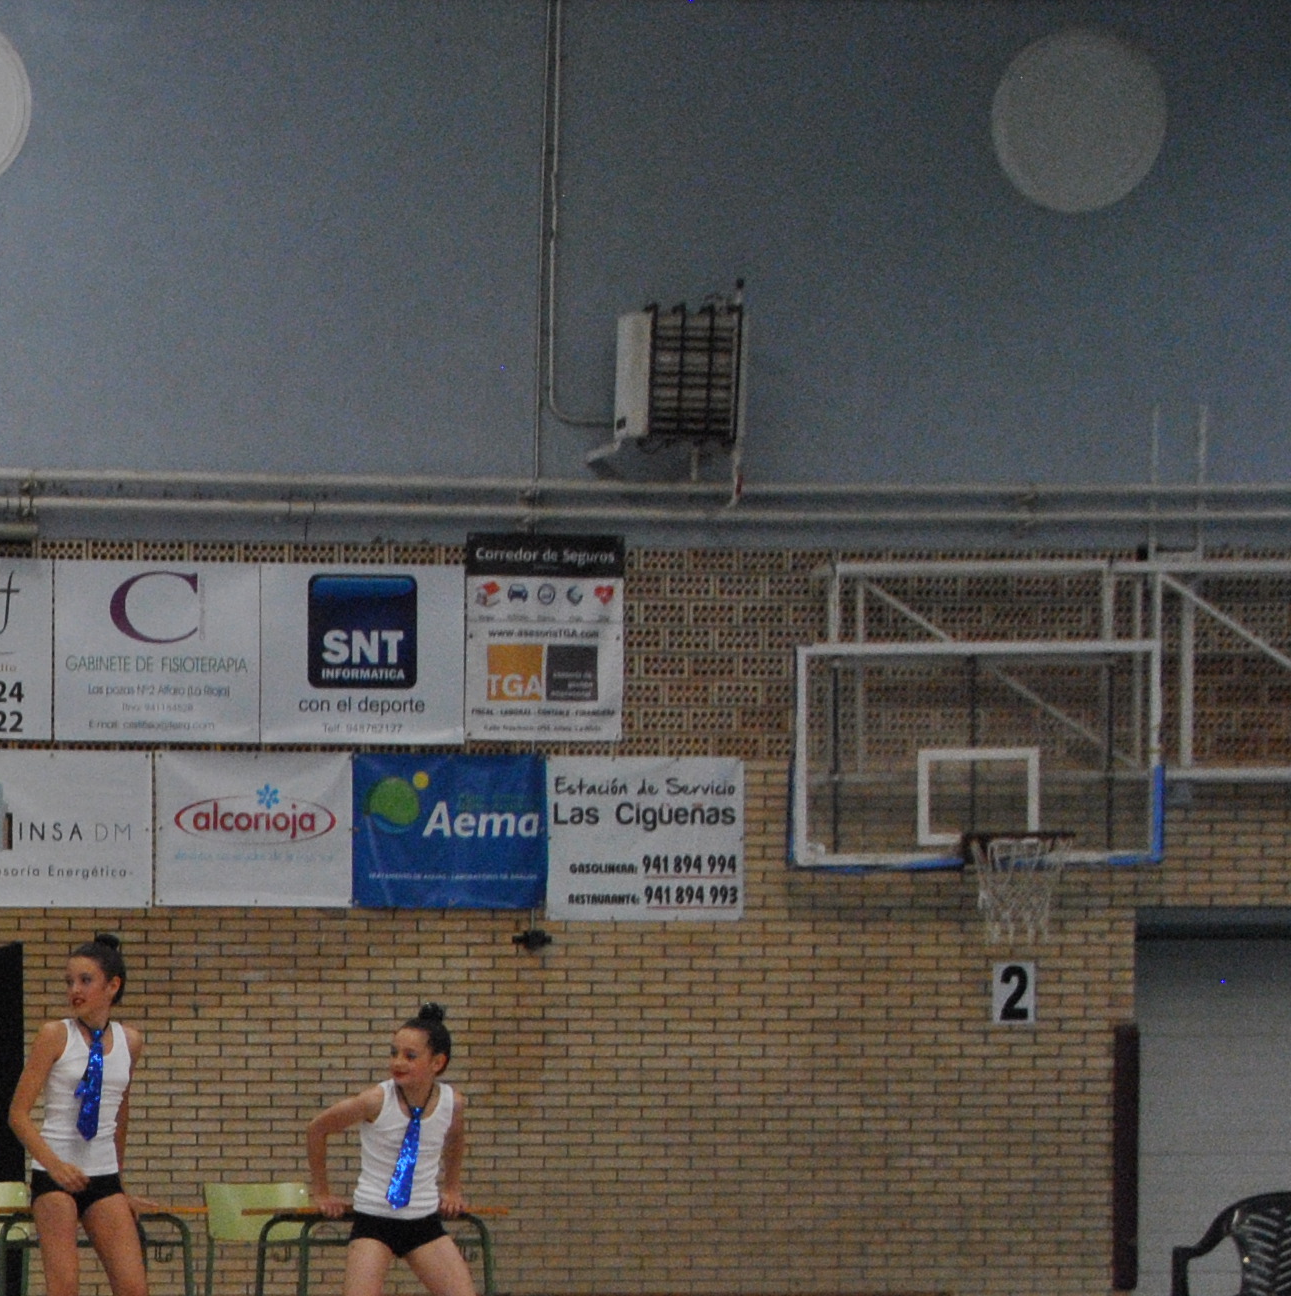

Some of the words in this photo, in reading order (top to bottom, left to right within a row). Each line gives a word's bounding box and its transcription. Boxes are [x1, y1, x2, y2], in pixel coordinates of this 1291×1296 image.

[475, 547, 537, 562] Corredor
[542, 548, 558, 562] de
[562, 549, 616, 566] Seguros
[321, 629, 405, 665] SNT
[65, 655, 132, 673] GABINETE
[135, 656, 154, 673] DE
[161, 656, 249, 674] FISIOTERAPIA
[487, 673, 543, 697] TGA
[299, 699, 331, 713] con
[336, 697, 351, 712] el
[357, 697, 426, 716] deporte
[554, 775, 628, 796] Estación
[636, 777, 659, 796] de
[665, 777, 736, 796] Servicio
[192, 801, 316, 839] alcorioja
[422, 800, 540, 838] Aema
[553, 802, 600, 825] Las
[615, 801, 736, 832] Cigüeñas
[642, 854, 669, 875] 941
[673, 854, 702, 875] 894
[707, 855, 737, 875] 994
[644, 885, 671, 905] 941
[675, 885, 704, 906] 894
[709, 885, 739, 906] 993
[999, 966, 1029, 1021] 2
